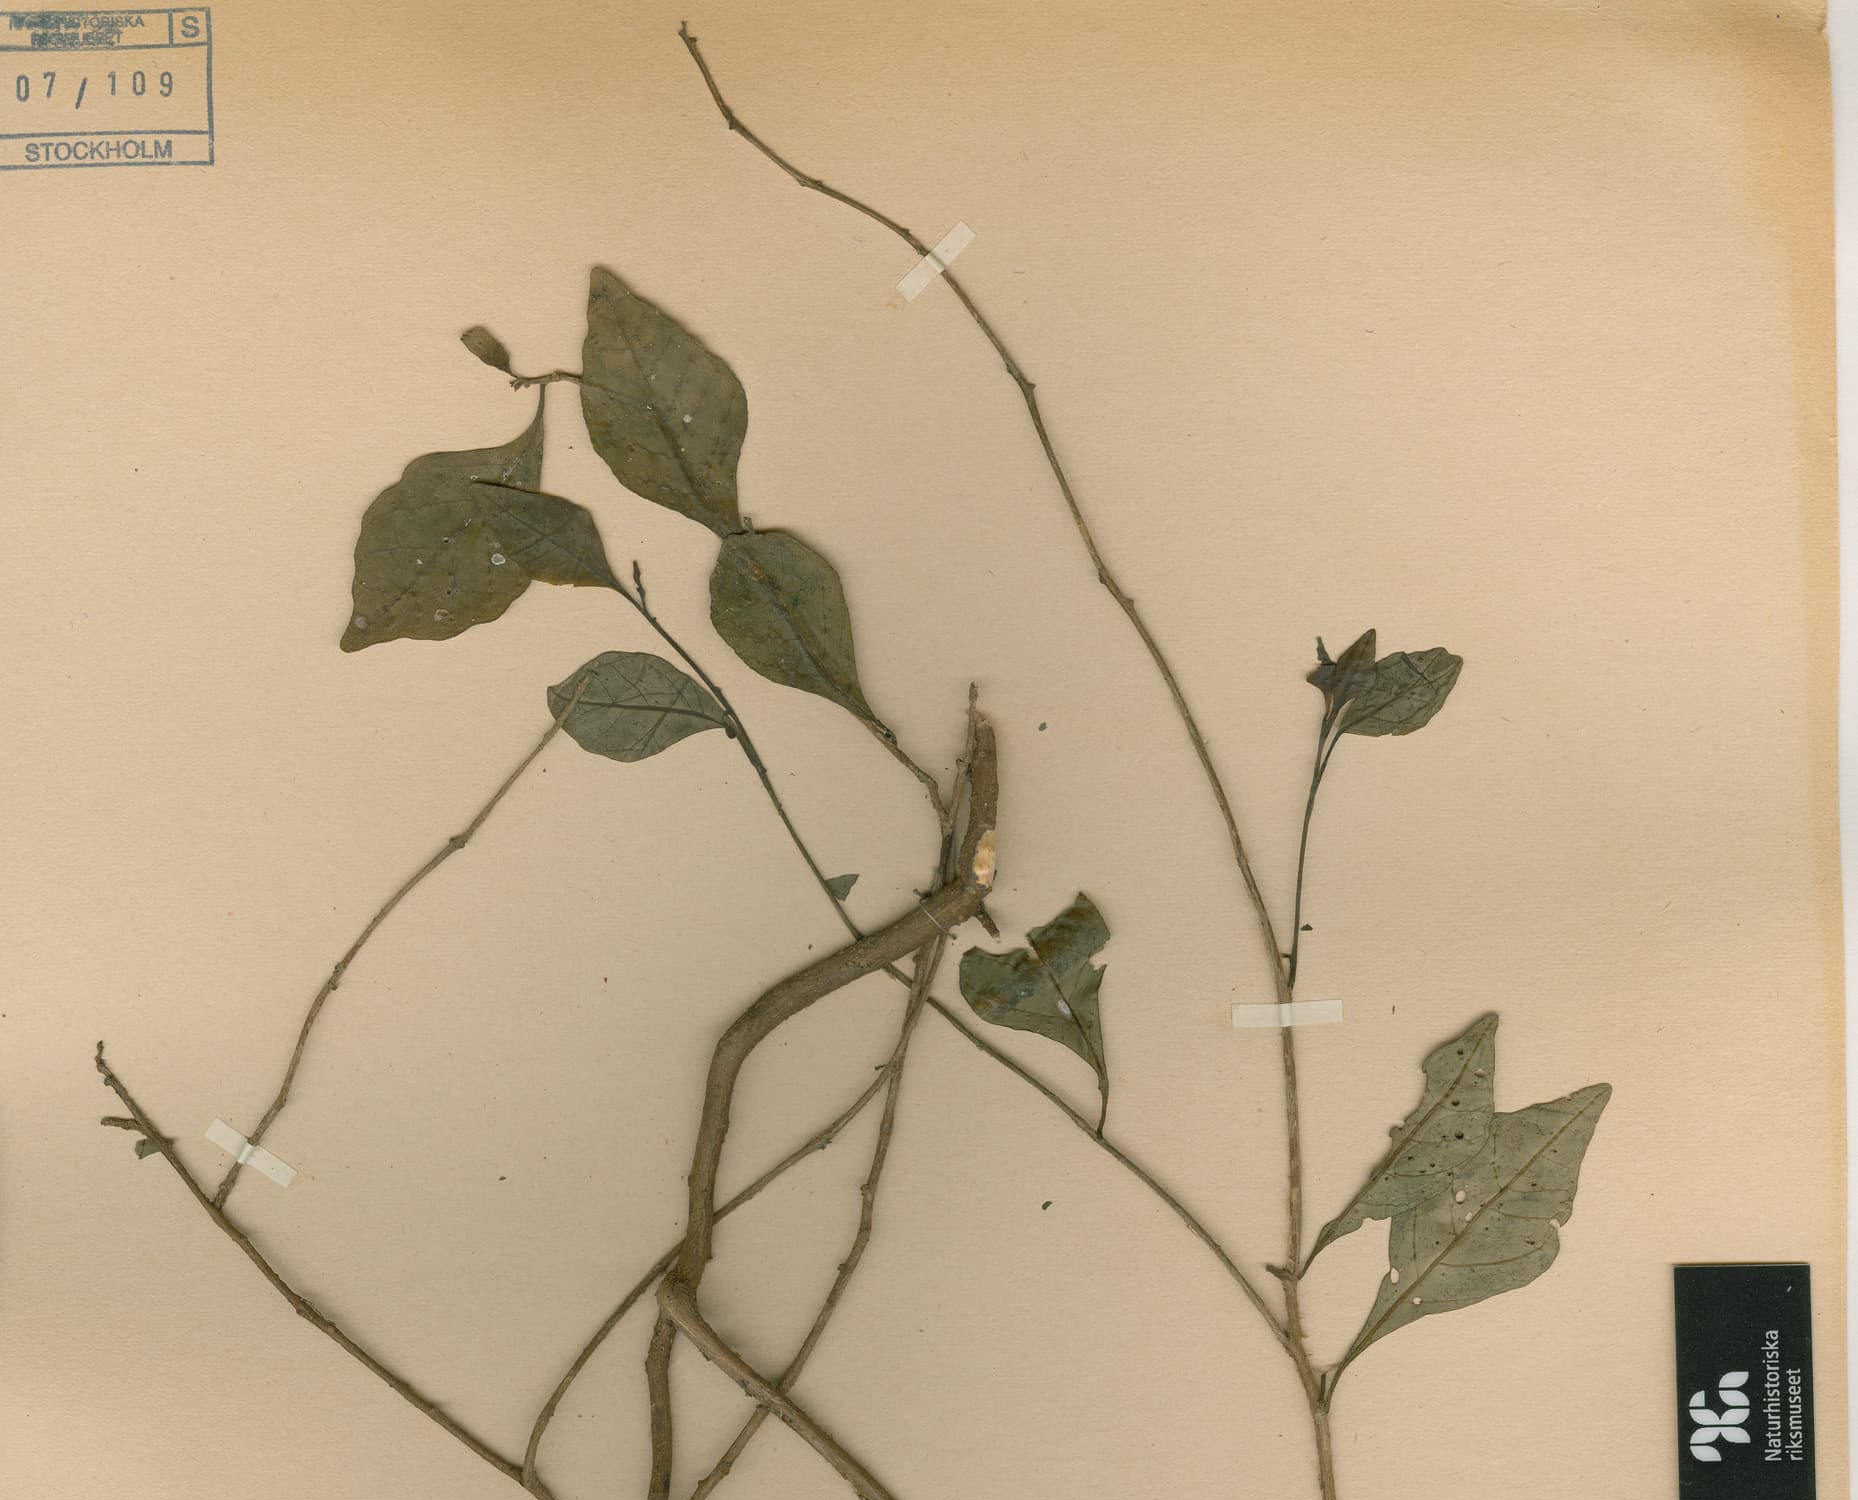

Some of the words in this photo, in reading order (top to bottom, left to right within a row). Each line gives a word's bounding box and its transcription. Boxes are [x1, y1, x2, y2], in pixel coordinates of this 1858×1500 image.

[181, 16, 200, 38] S
[25, 139, 173, 162] STOCKHOLM
[1761, 1329, 1782, 1462] Naturhistoriska
[1785, 1368, 1803, 1461] riksmuseet
